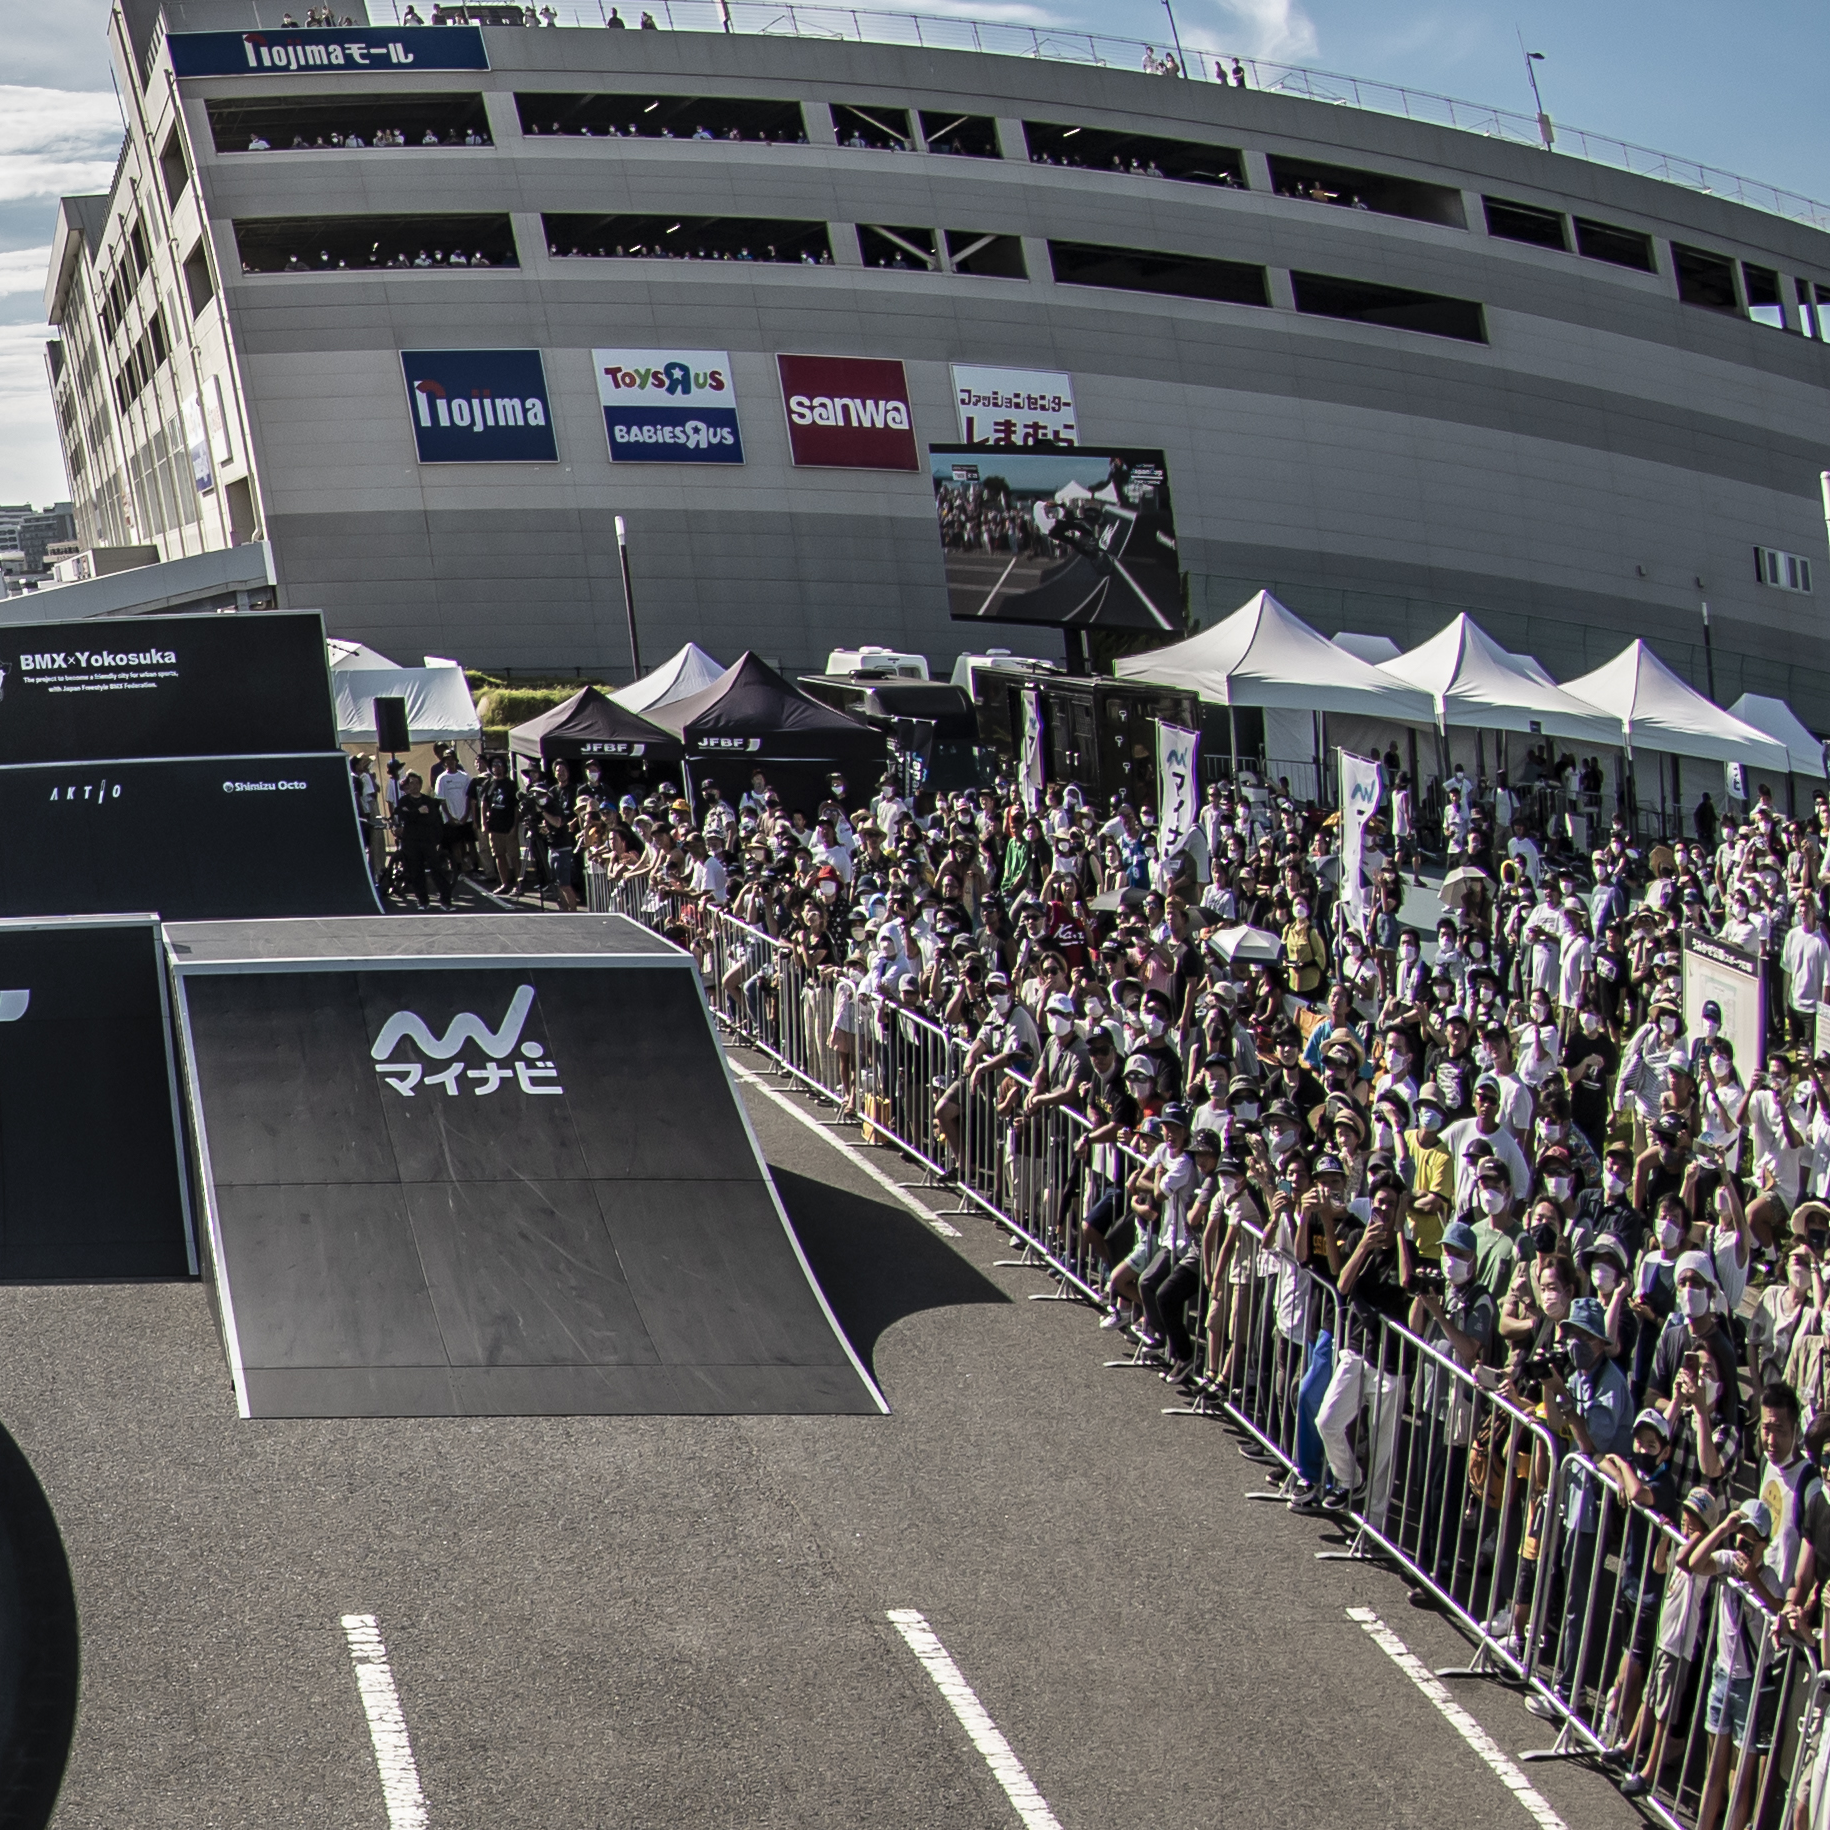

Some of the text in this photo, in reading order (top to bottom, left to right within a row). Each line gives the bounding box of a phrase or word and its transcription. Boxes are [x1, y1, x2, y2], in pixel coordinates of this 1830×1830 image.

[959, 388, 1072, 413] ファッションセンター
[790, 395, 909, 429] sanwa
[36, 676, 57, 684] project
[94, 673, 117, 681] friendly
[118, 672, 129, 680] city
[82, 683, 109, 691] Freestyle
[581, 743, 628, 753] JFBF
[698, 737, 744, 747] JFBF
[49, 779, 121, 804] AKTIO
[234, 780, 307, 792] Shimizu Octo
[374, 1061, 564, 1097] マイナビ
